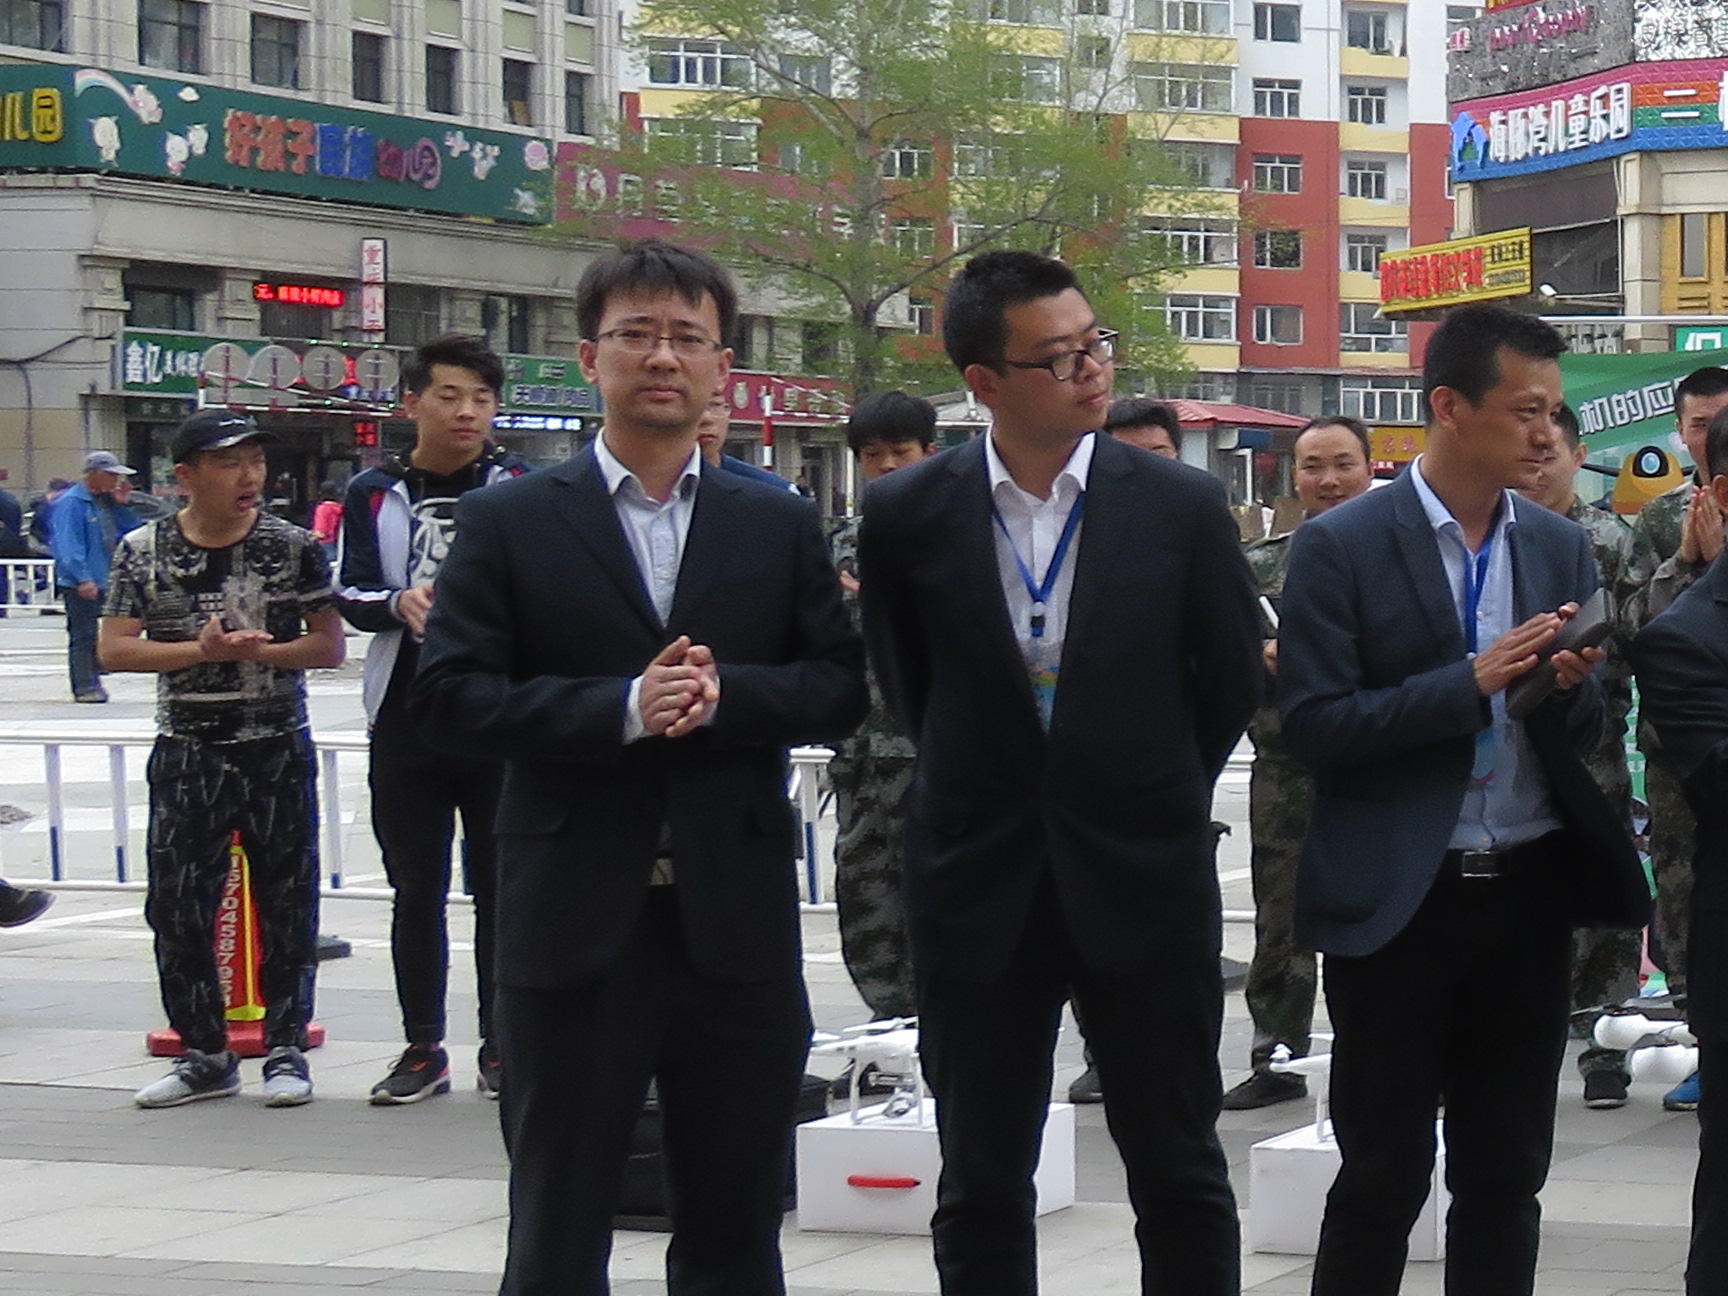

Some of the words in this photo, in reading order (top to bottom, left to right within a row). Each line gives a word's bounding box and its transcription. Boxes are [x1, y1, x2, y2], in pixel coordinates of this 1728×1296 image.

[0, 88, 64, 142] 儿园
[1578, 376, 1686, 436] 机的应
